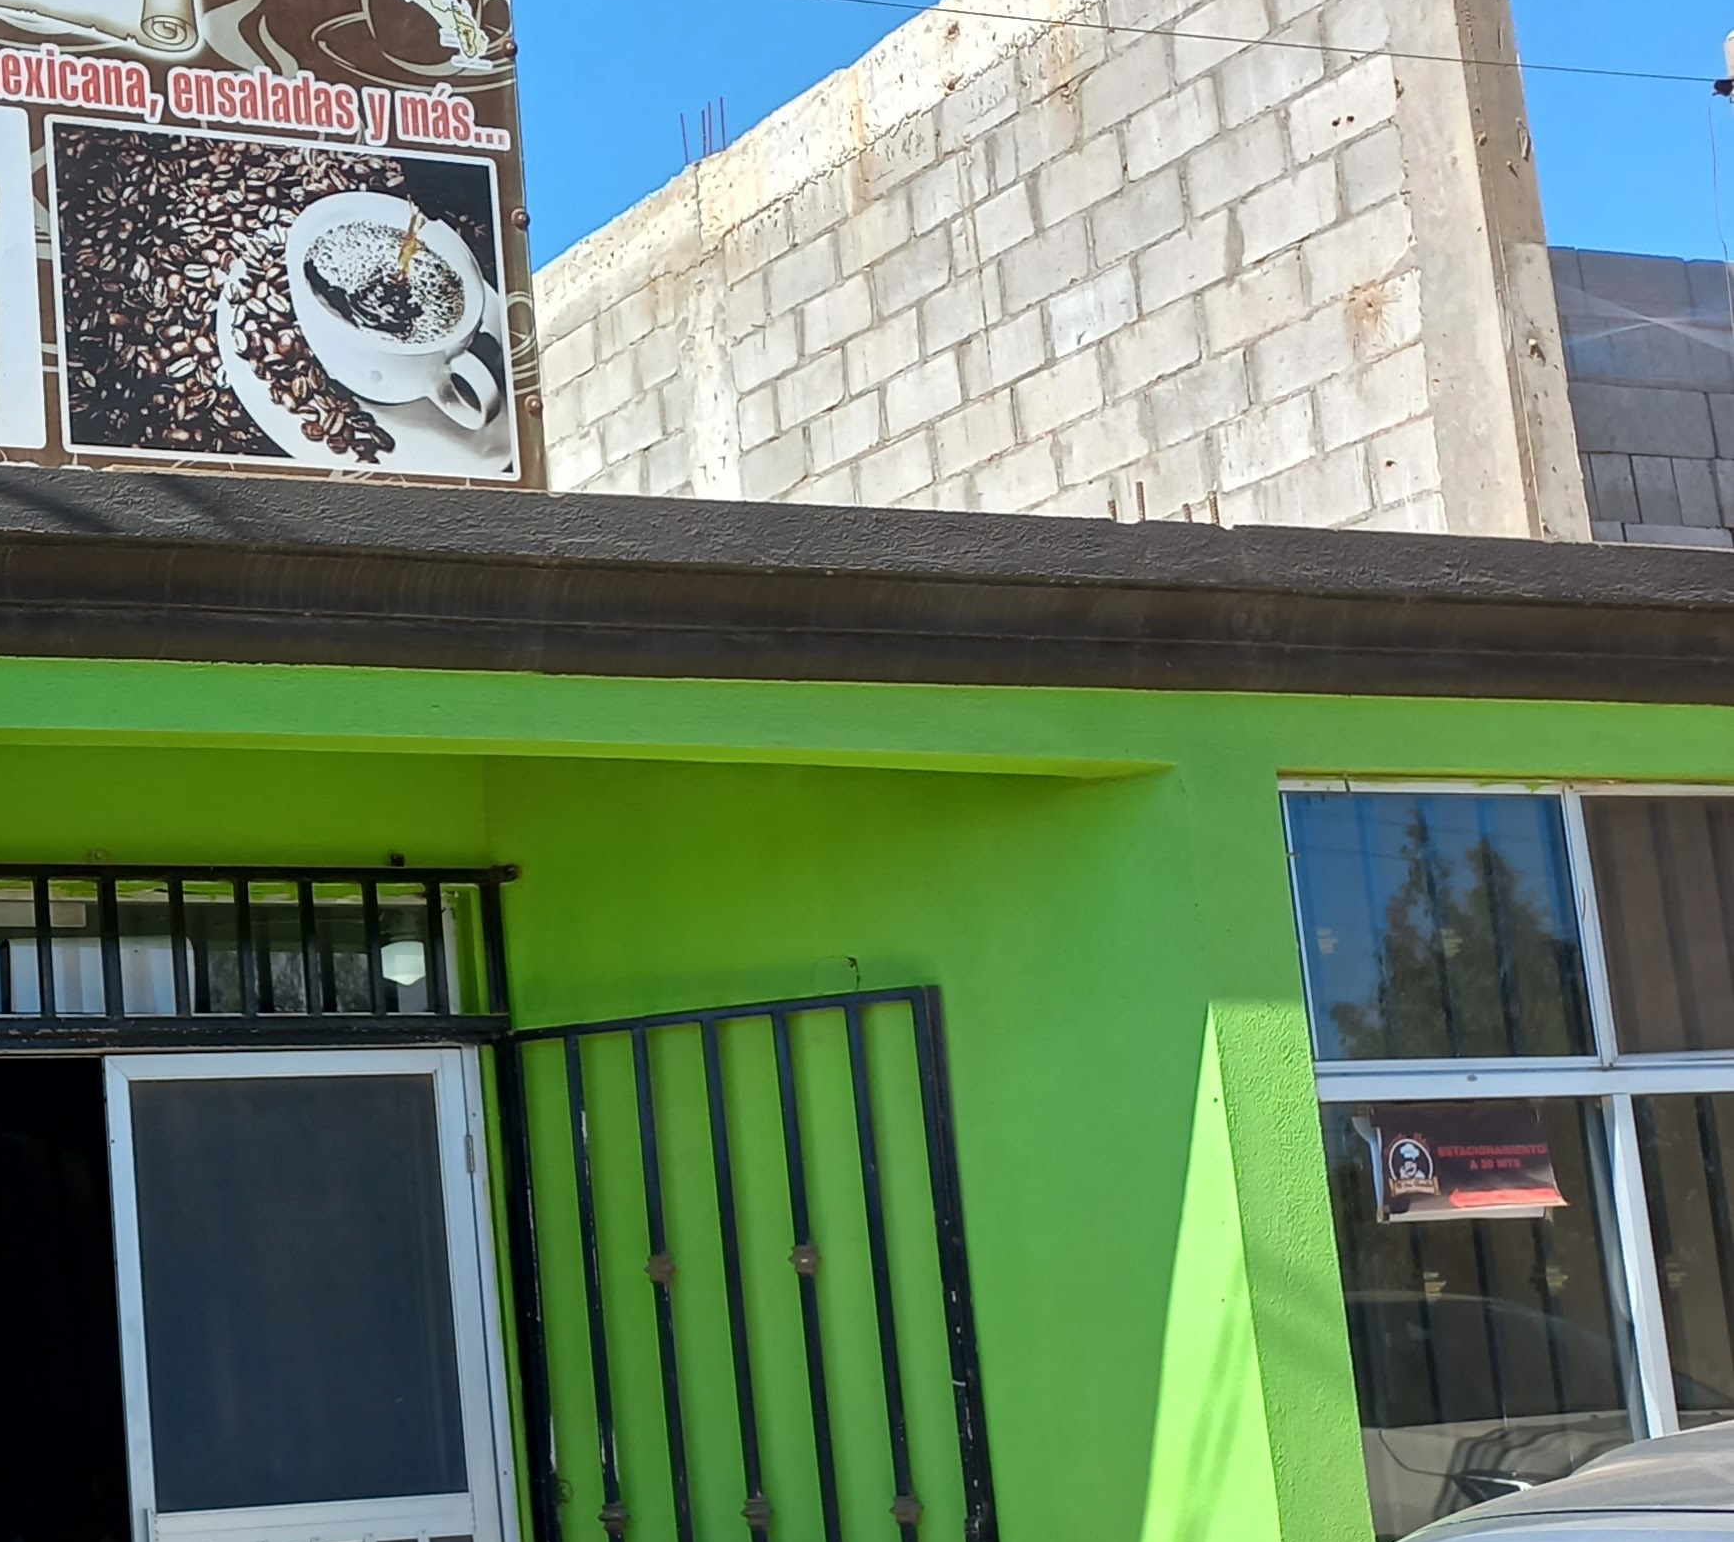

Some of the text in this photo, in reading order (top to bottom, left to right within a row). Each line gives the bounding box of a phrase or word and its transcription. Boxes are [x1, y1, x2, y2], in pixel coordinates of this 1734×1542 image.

[172, 70, 356, 130] ensaladas
[366, 91, 390, 141] y
[400, 86, 506, 146] más...
